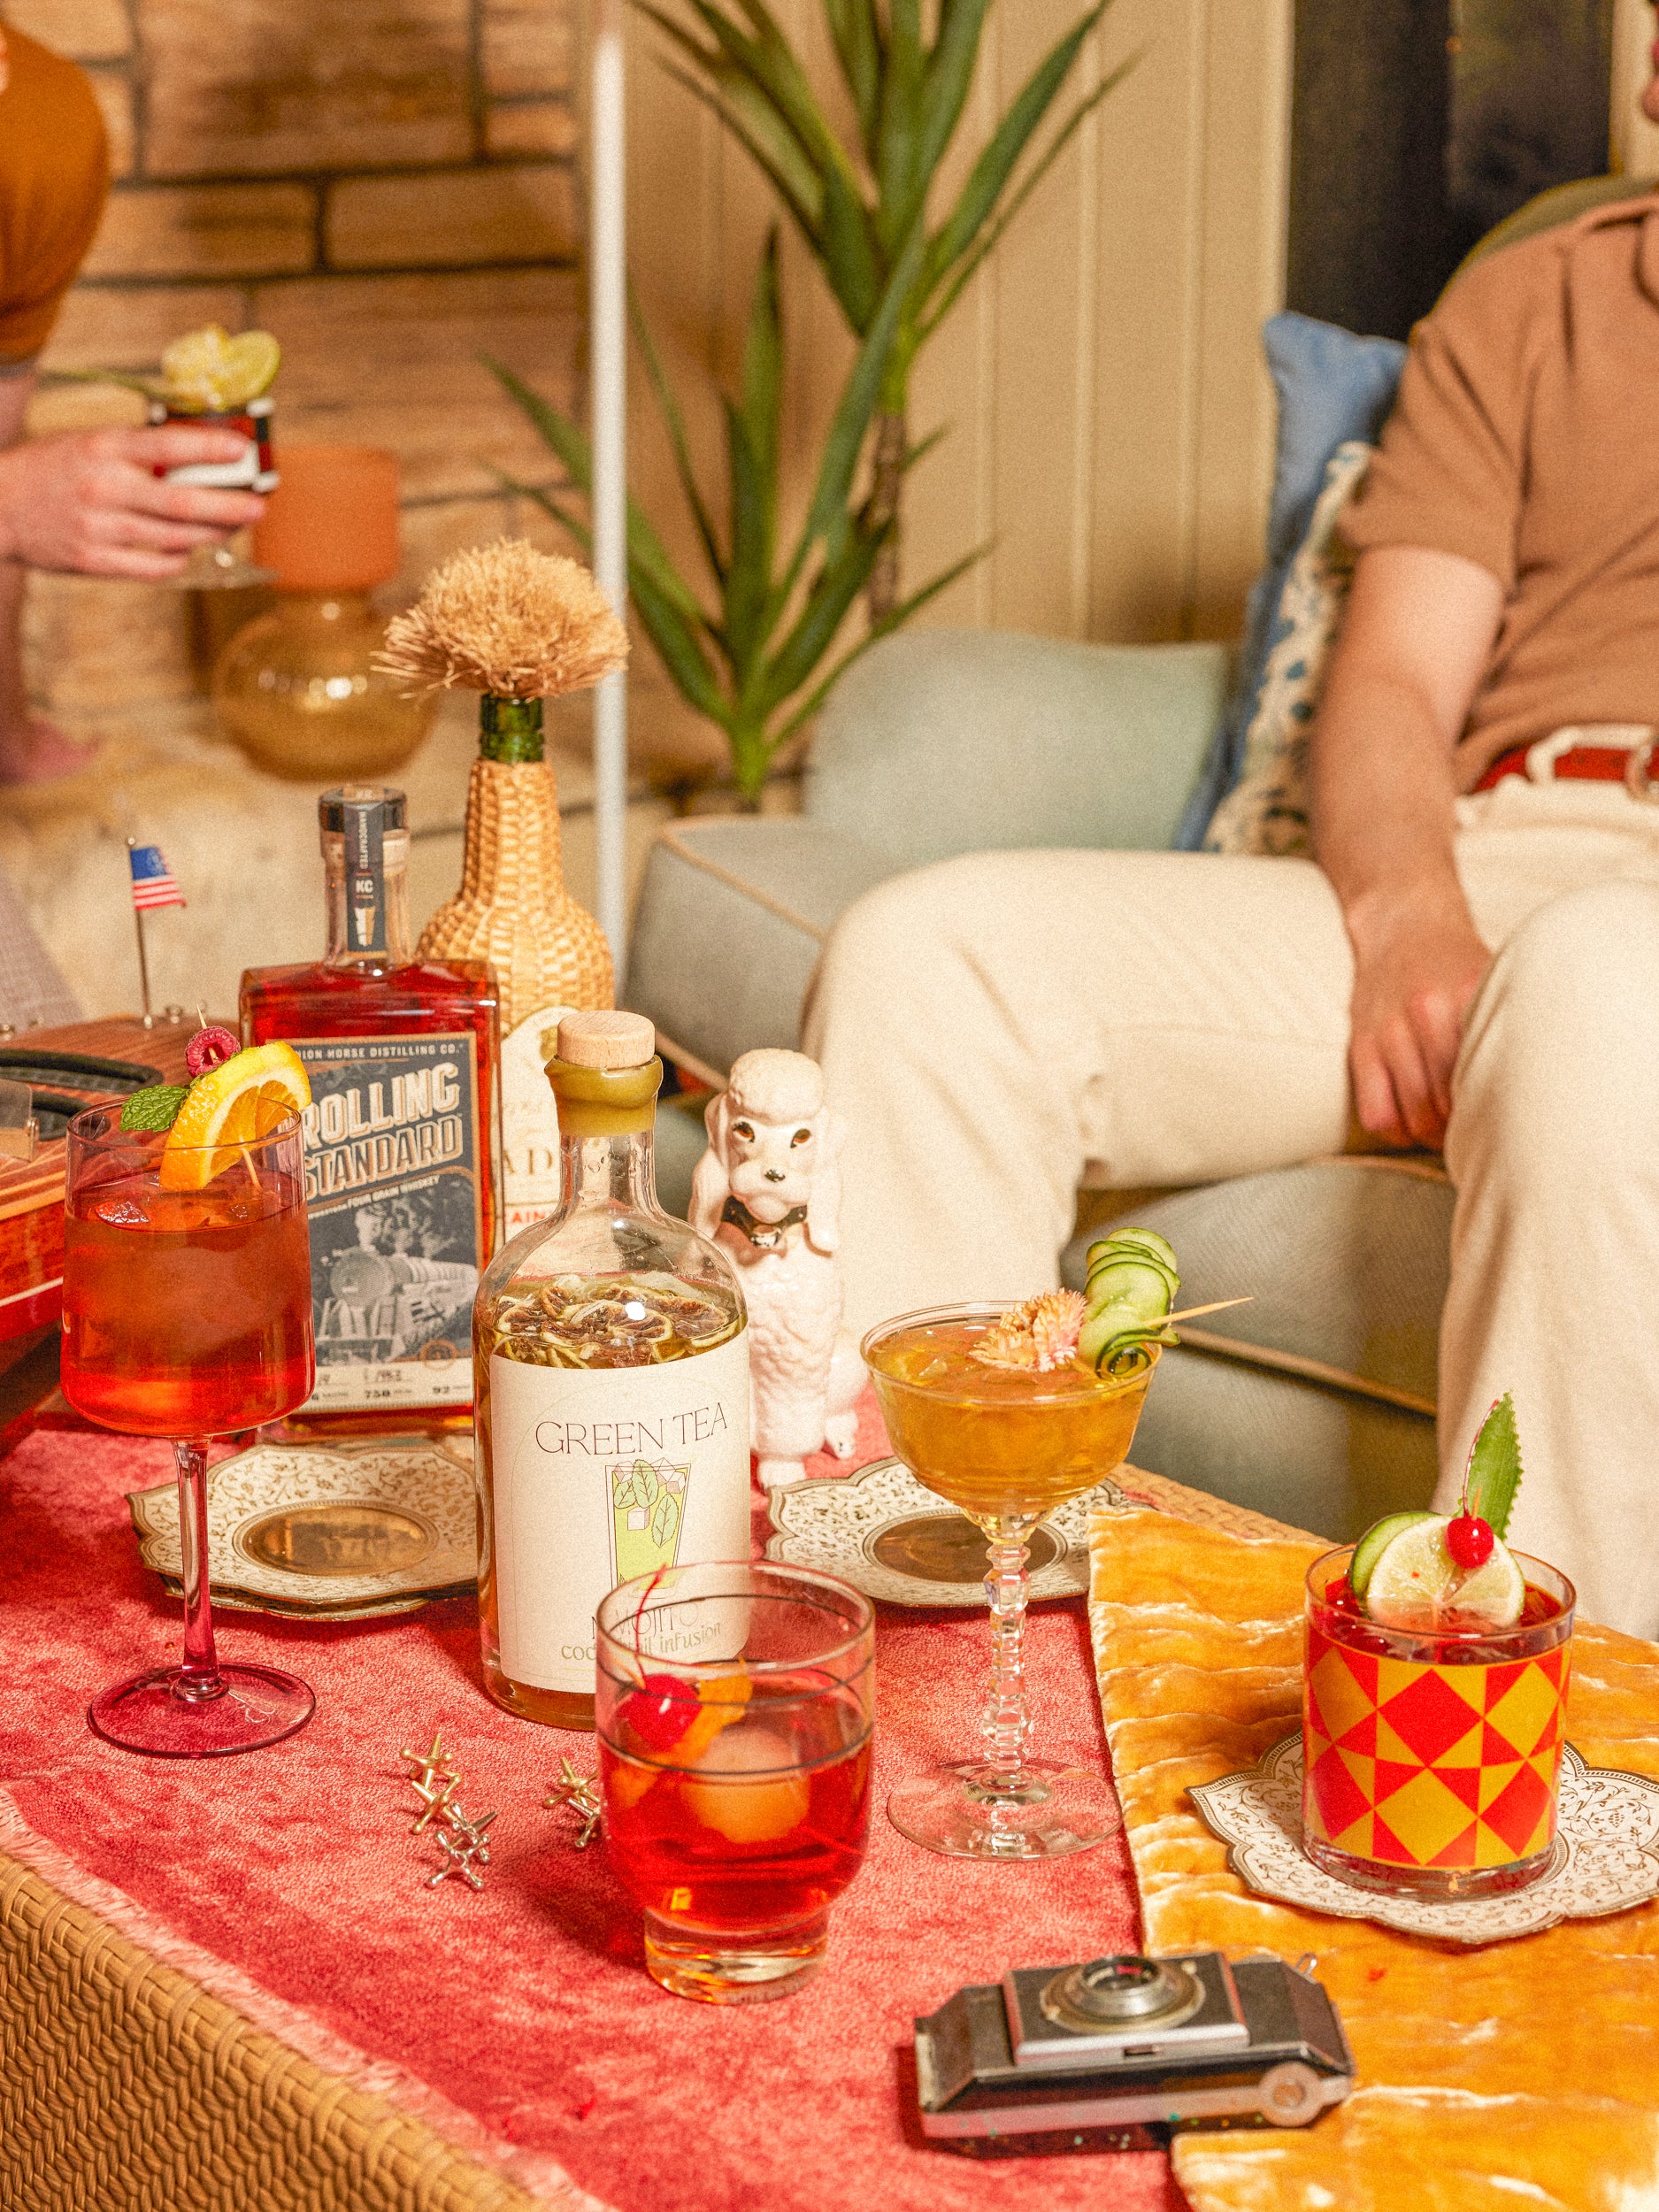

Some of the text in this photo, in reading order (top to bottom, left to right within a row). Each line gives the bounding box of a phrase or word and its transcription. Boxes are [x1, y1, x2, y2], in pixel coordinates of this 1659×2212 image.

[356, 879, 373, 893] KC
[296, 1048, 322, 1060] NION
[326, 1048, 365, 1059] HORSE
[369, 1045, 435, 1057] DISTILLING
[302, 1062, 460, 1151] ROLLING
[304, 1114, 464, 1201] STANDARD
[400, 1174, 441, 1193] WHISKEY
[535, 1402, 727, 1455] GREEN TEA
[659, 1622, 721, 1655] infusion
